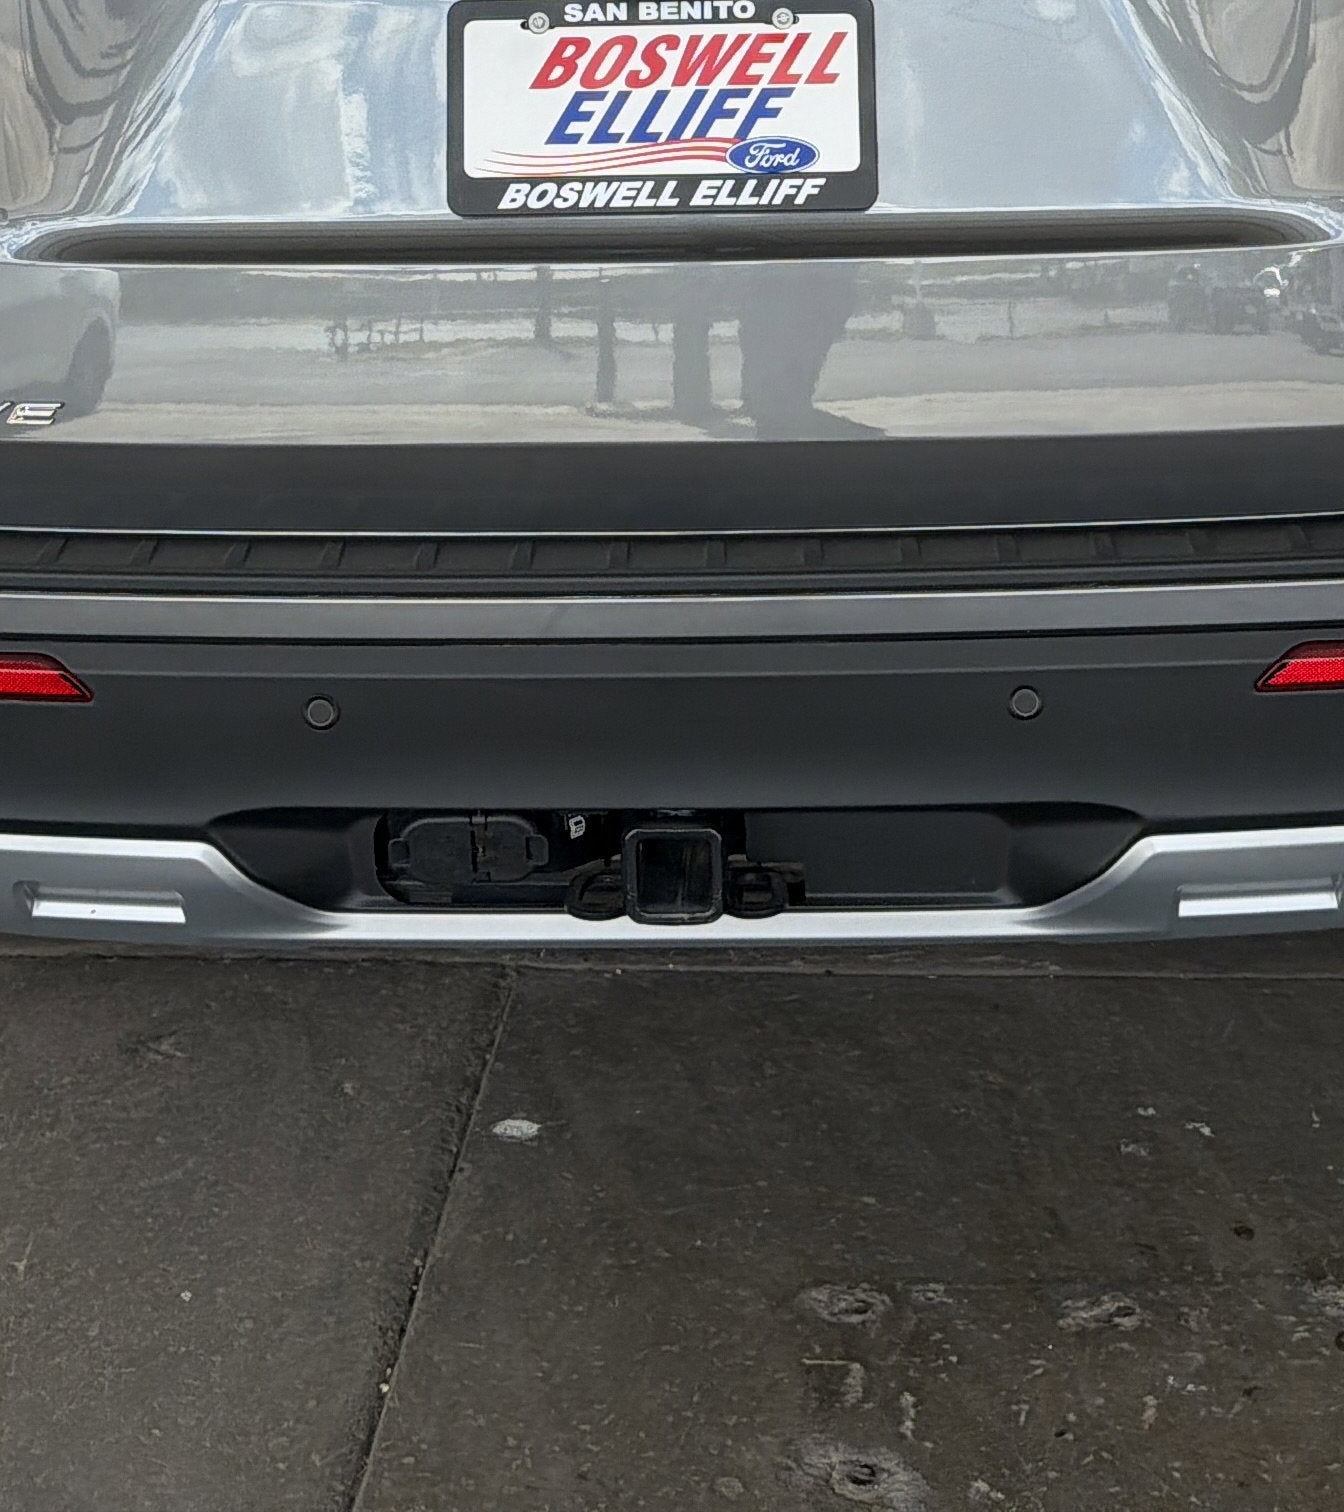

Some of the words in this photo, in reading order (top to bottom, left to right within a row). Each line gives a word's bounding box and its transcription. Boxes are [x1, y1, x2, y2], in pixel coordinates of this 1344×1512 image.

[563, 1, 628, 23] SAN
[638, 0, 756, 22] BENITO
[528, 31, 848, 90] BOSWELL
[544, 87, 797, 145] ELLIFF
[744, 141, 802, 170] Ford
[497, 178, 682, 210] BOSWELL
[689, 176, 827, 207] ELLIFF
